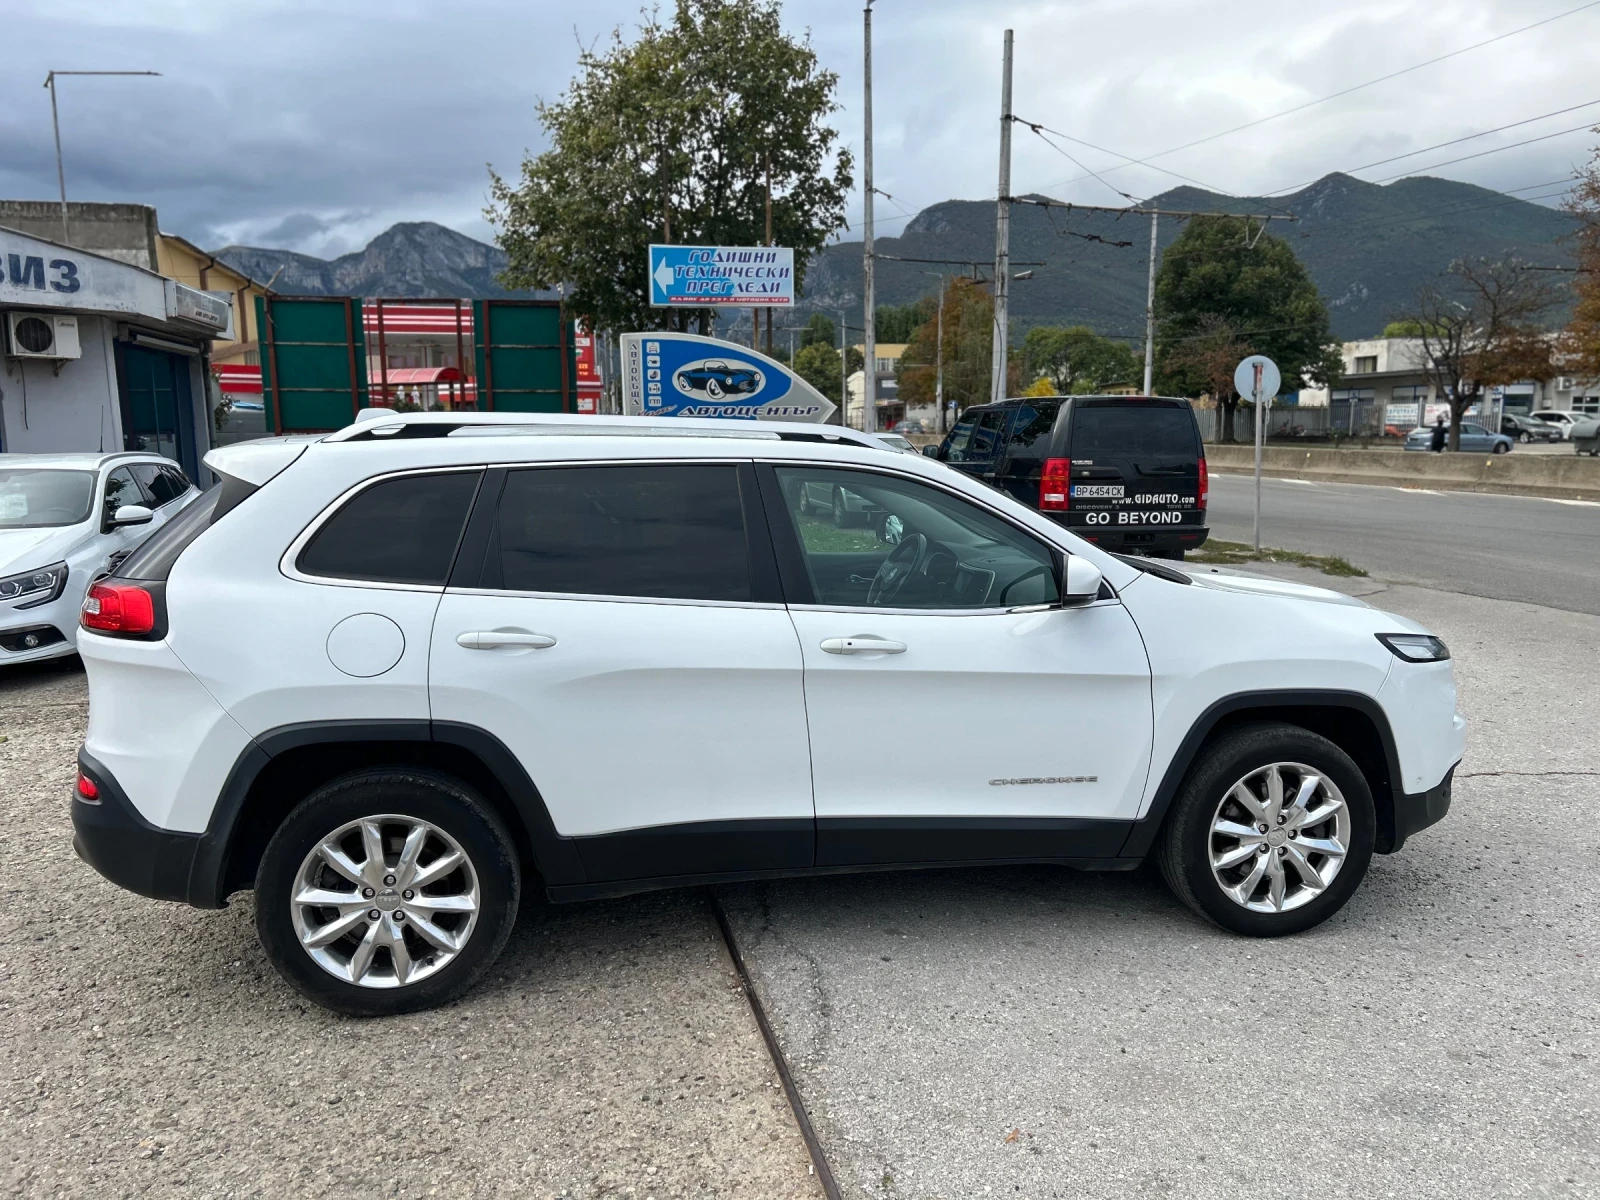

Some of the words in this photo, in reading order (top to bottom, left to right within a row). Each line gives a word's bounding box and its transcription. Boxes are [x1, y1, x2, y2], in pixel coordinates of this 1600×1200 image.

[688, 251, 777, 264] ГОДИШНИ
[675, 266, 790, 279] ТЕХНИЧЕСКИ
[686, 281, 781, 294] ПРЕГЛЕДИ
[629, 343, 640, 406] АВТОКЪЩА
[677, 405, 820, 417] АВТОЦЕНТЪР
[1089, 487, 1110, 496] 6454
[1111, 487, 1123, 496] CK
[1085, 512, 1110, 525] GO
[1118, 511, 1182, 524] BEYOND
[988, 776, 1098, 786] CHEROKEE
